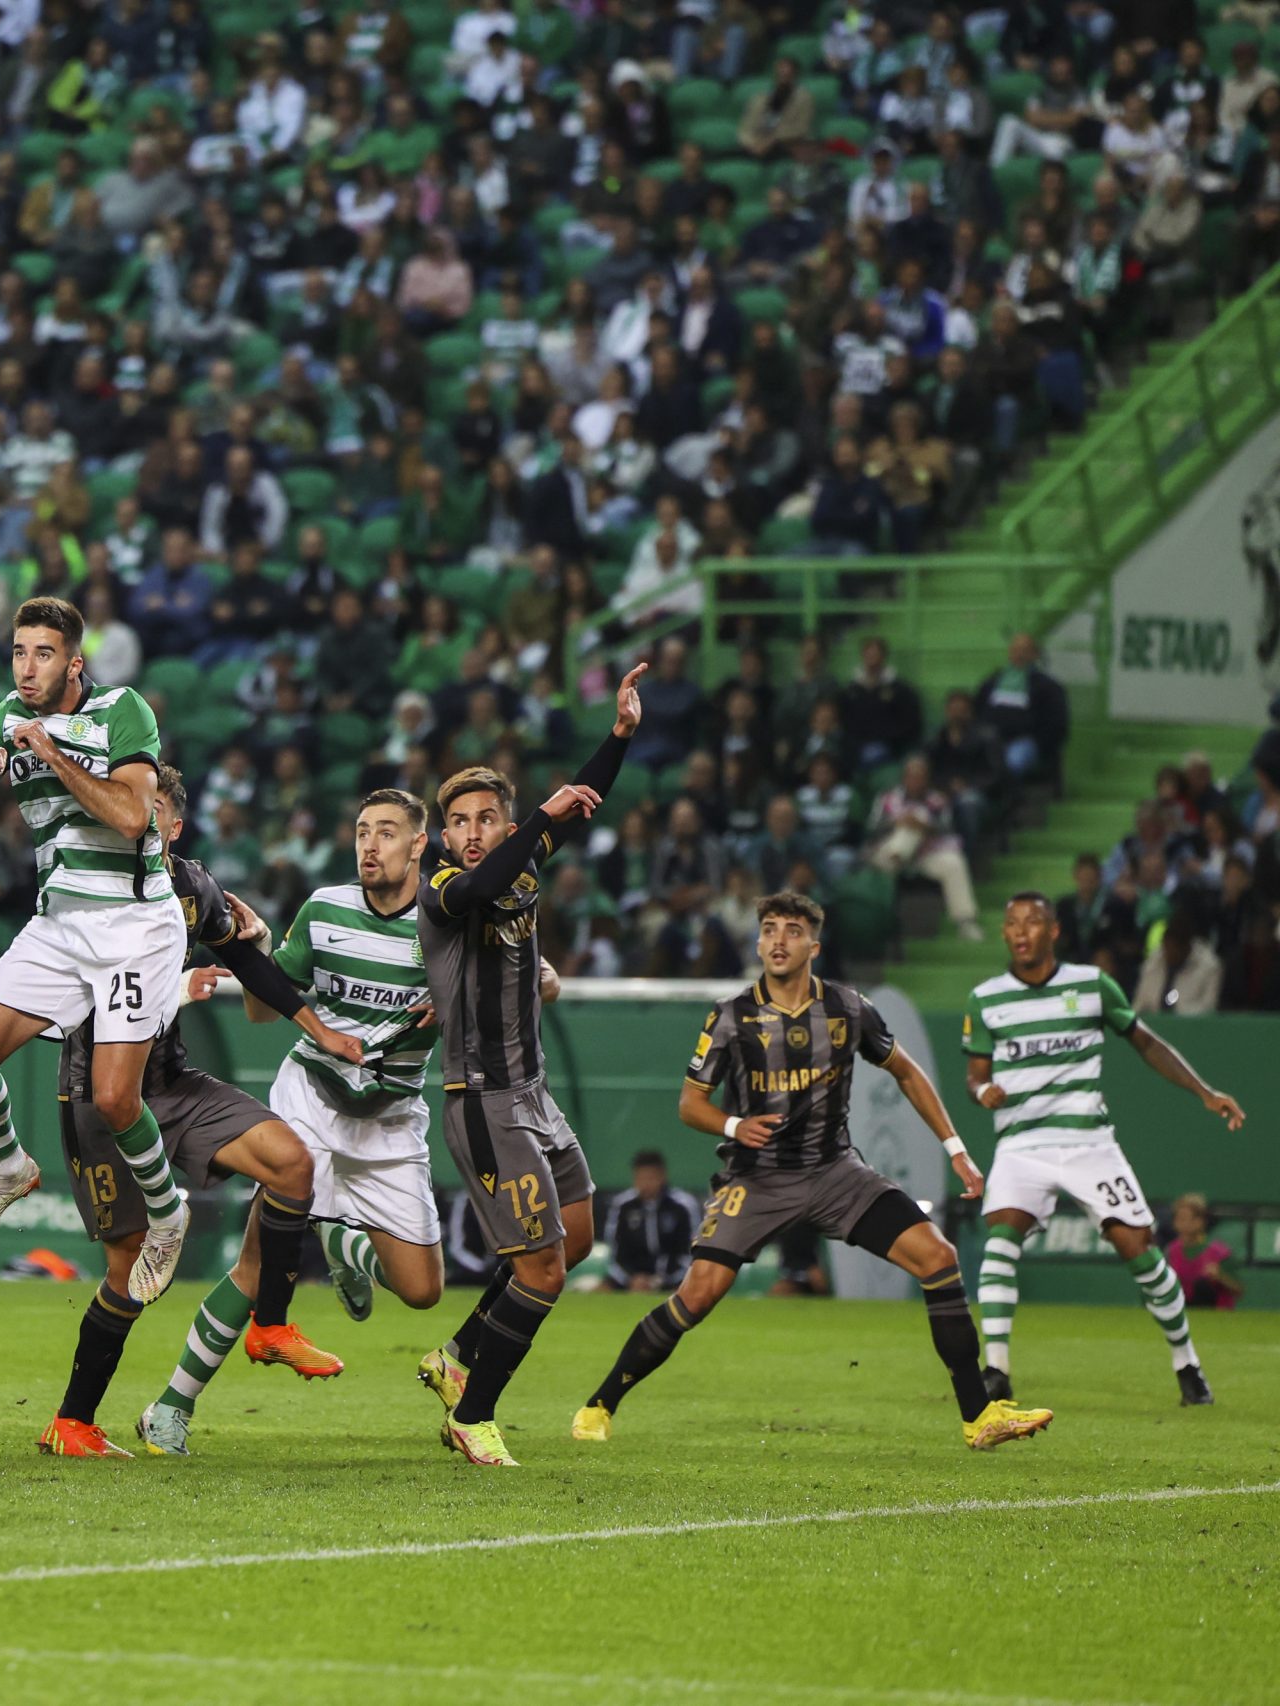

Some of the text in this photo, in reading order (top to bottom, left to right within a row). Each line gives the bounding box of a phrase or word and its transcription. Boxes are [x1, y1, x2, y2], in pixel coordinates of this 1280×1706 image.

[109, 972, 143, 1012] 25
[85, 1163, 117, 1206] 13
[500, 1173, 548, 1219] 72
[1097, 1177, 1137, 1206] 33
